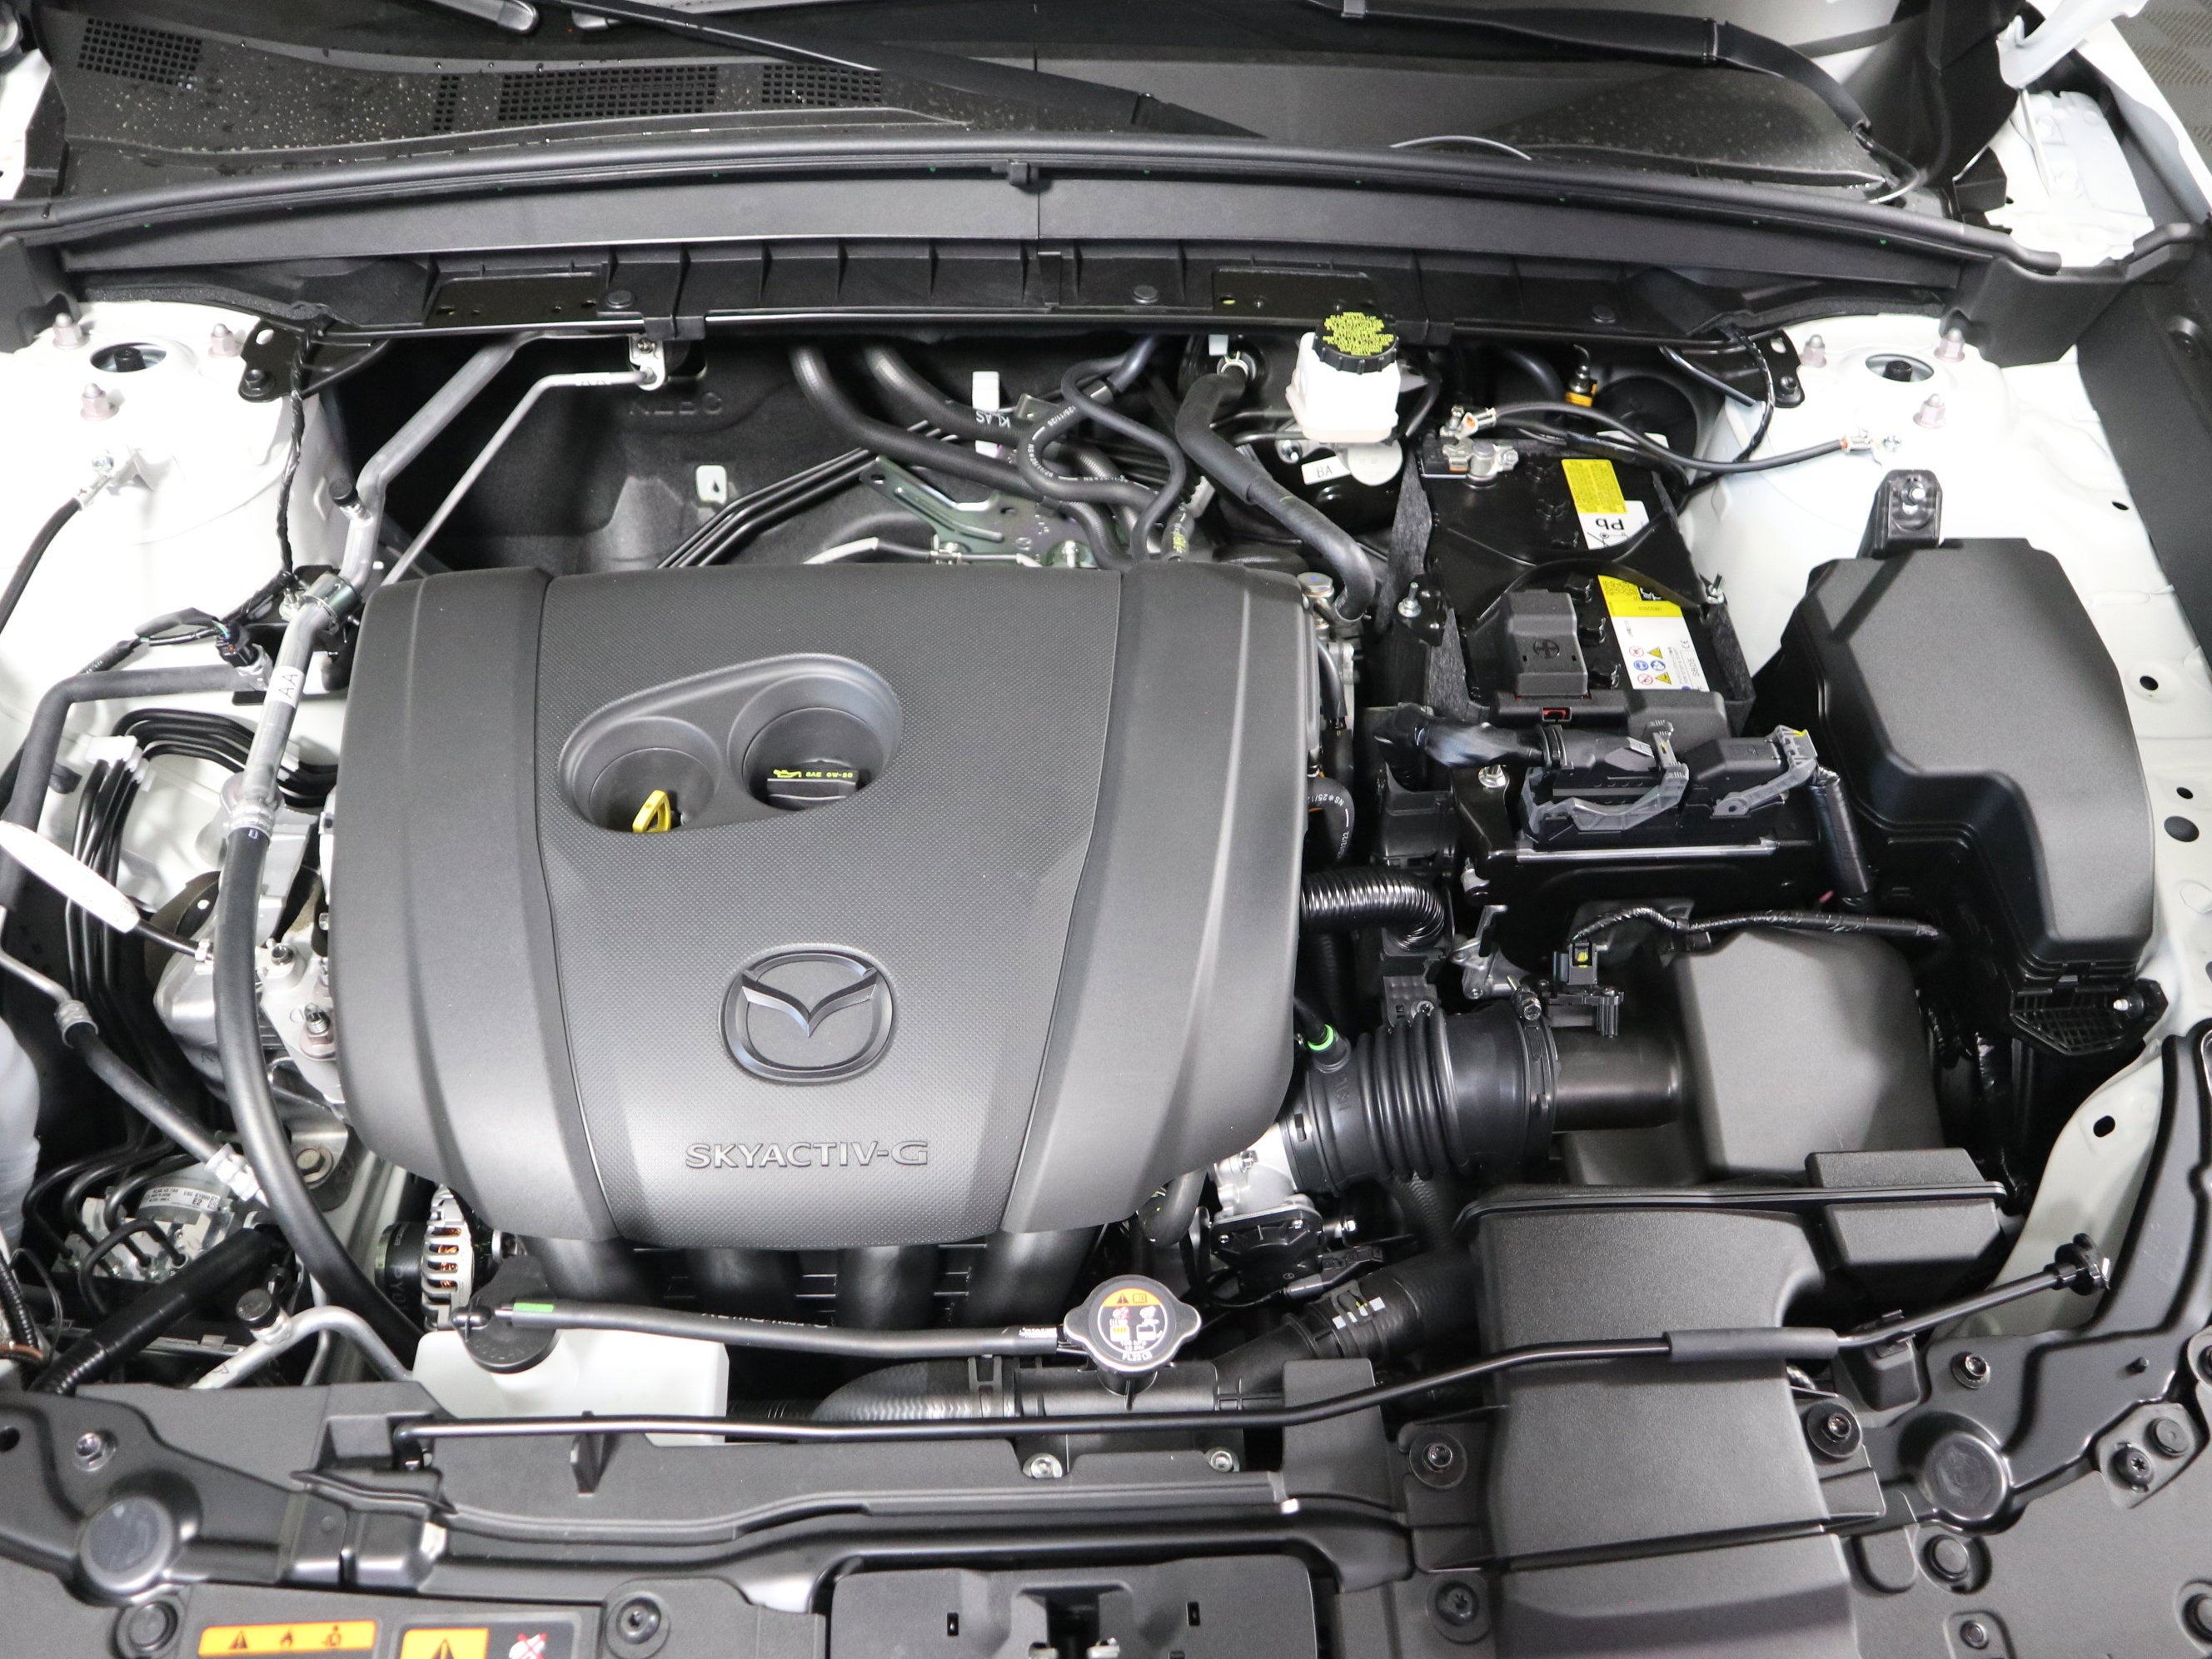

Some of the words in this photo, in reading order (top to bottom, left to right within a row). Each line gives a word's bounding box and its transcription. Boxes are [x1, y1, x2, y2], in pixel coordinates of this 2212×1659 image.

[1316, 464, 1333, 478] BA
[1595, 517, 1625, 531] Pb
[277, 674, 298, 700] AA
[685, 1140, 929, 1169] SKYACTIV-G
